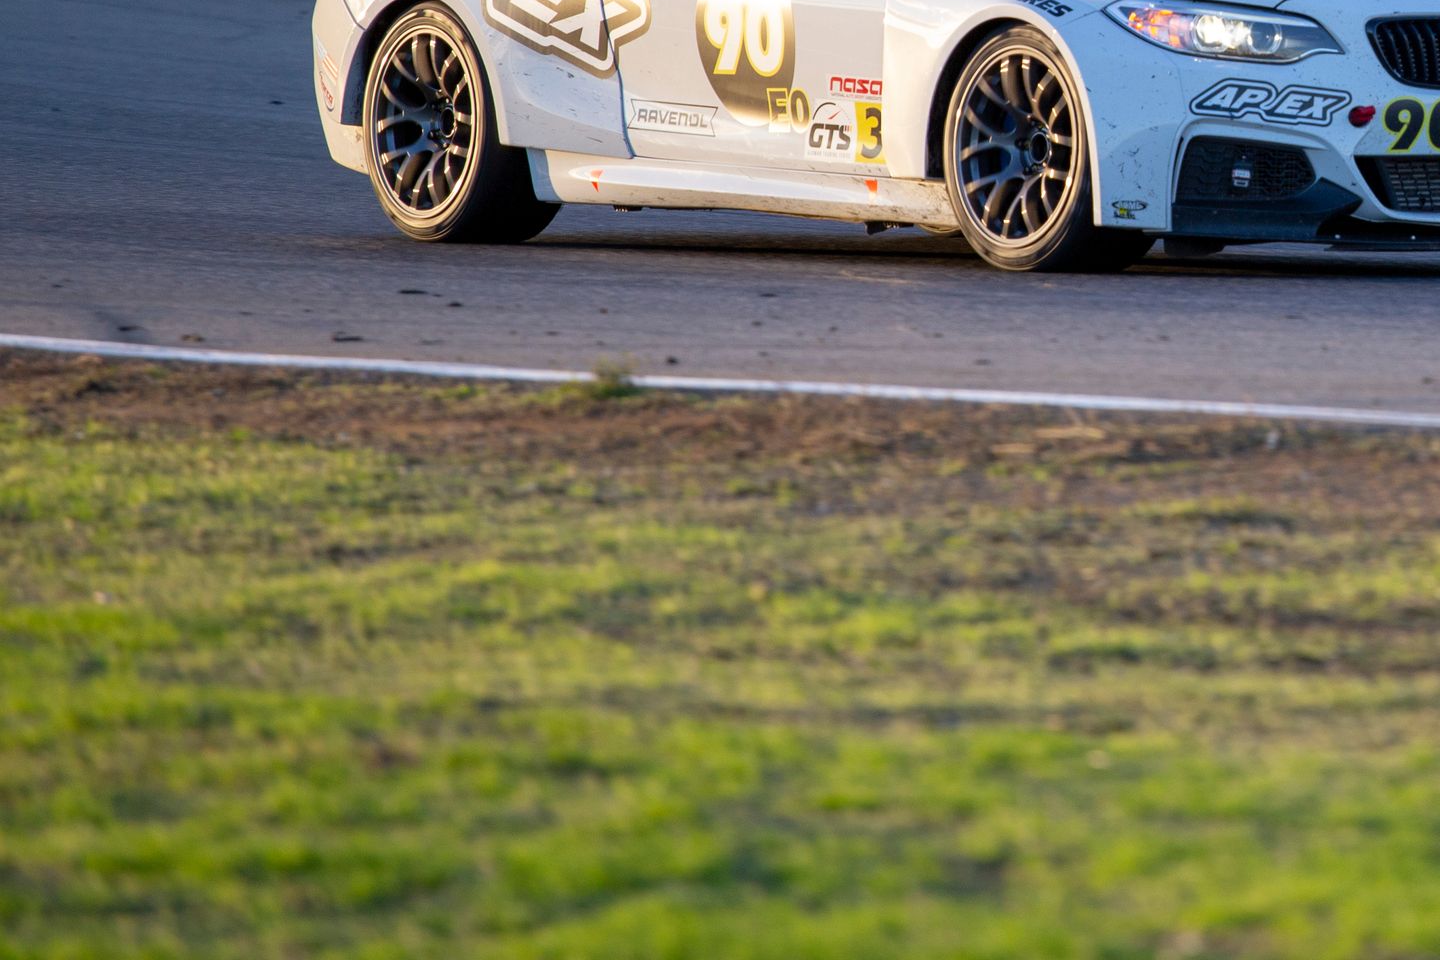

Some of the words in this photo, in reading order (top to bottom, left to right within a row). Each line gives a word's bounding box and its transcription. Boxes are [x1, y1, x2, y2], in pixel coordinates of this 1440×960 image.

[830, 76, 883, 95] nasa
[1202, 85, 1340, 120] APEX
[637, 108, 709, 129] RAVENOL
[808, 123, 851, 150] GTS
[861, 107, 883, 159] 3
